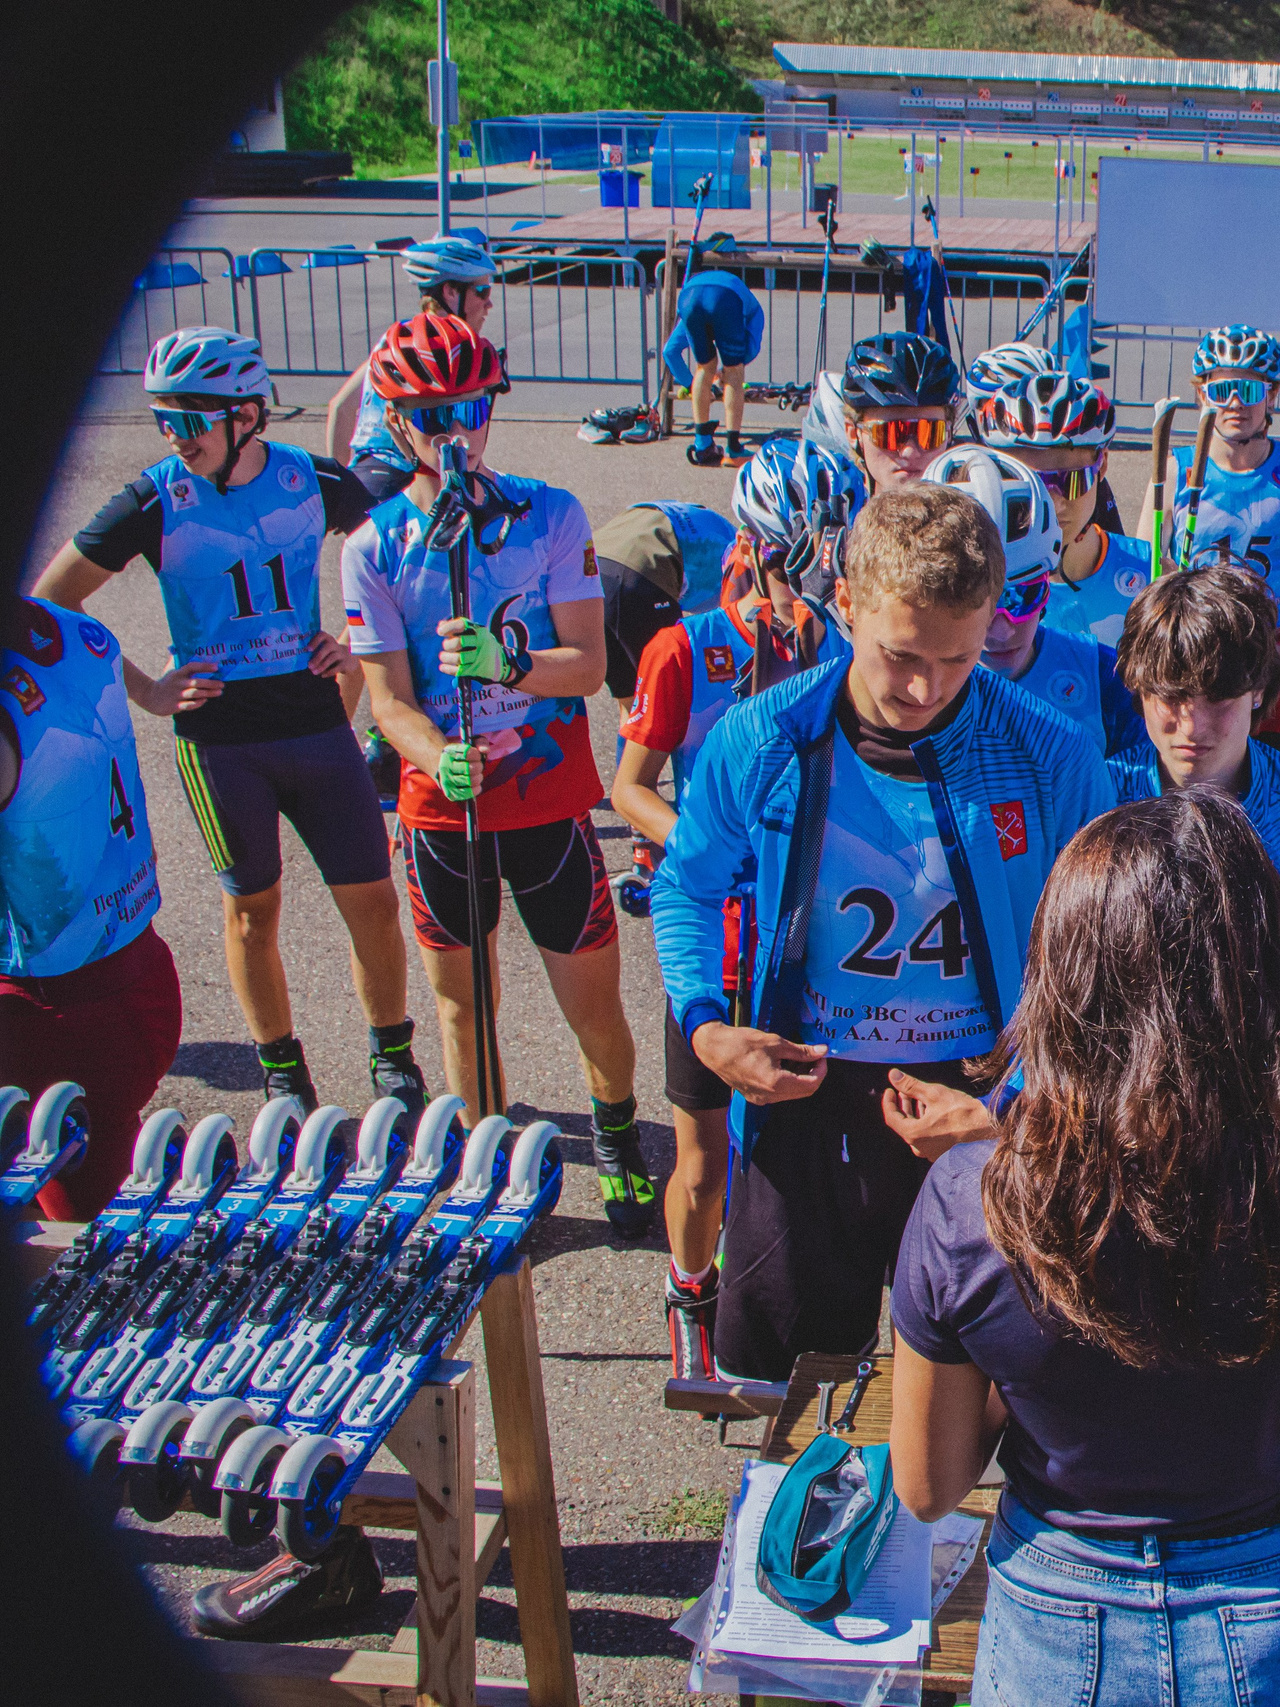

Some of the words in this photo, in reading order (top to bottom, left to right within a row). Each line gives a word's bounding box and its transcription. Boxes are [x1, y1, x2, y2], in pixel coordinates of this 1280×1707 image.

[222, 552, 294, 621] 11
[489, 592, 530, 668] 6
[248, 635, 273, 652] ЗВС
[110, 756, 136, 842] 4
[837, 885, 971, 980] 24
[832, 1005, 856, 1020] по
[861, 1004, 907, 1024] ЗВС
[815, 1017, 837, 1040] им
[843, 1026, 890, 1043] А.А.
[228, 1199, 243, 1211] 3
[105, 1217, 121, 1228] 4
[273, 1211, 289, 1222] 3
[156, 1220, 171, 1232] 4
[441, 1220, 453, 1232] 1
[493, 1223, 504, 1234] 1
